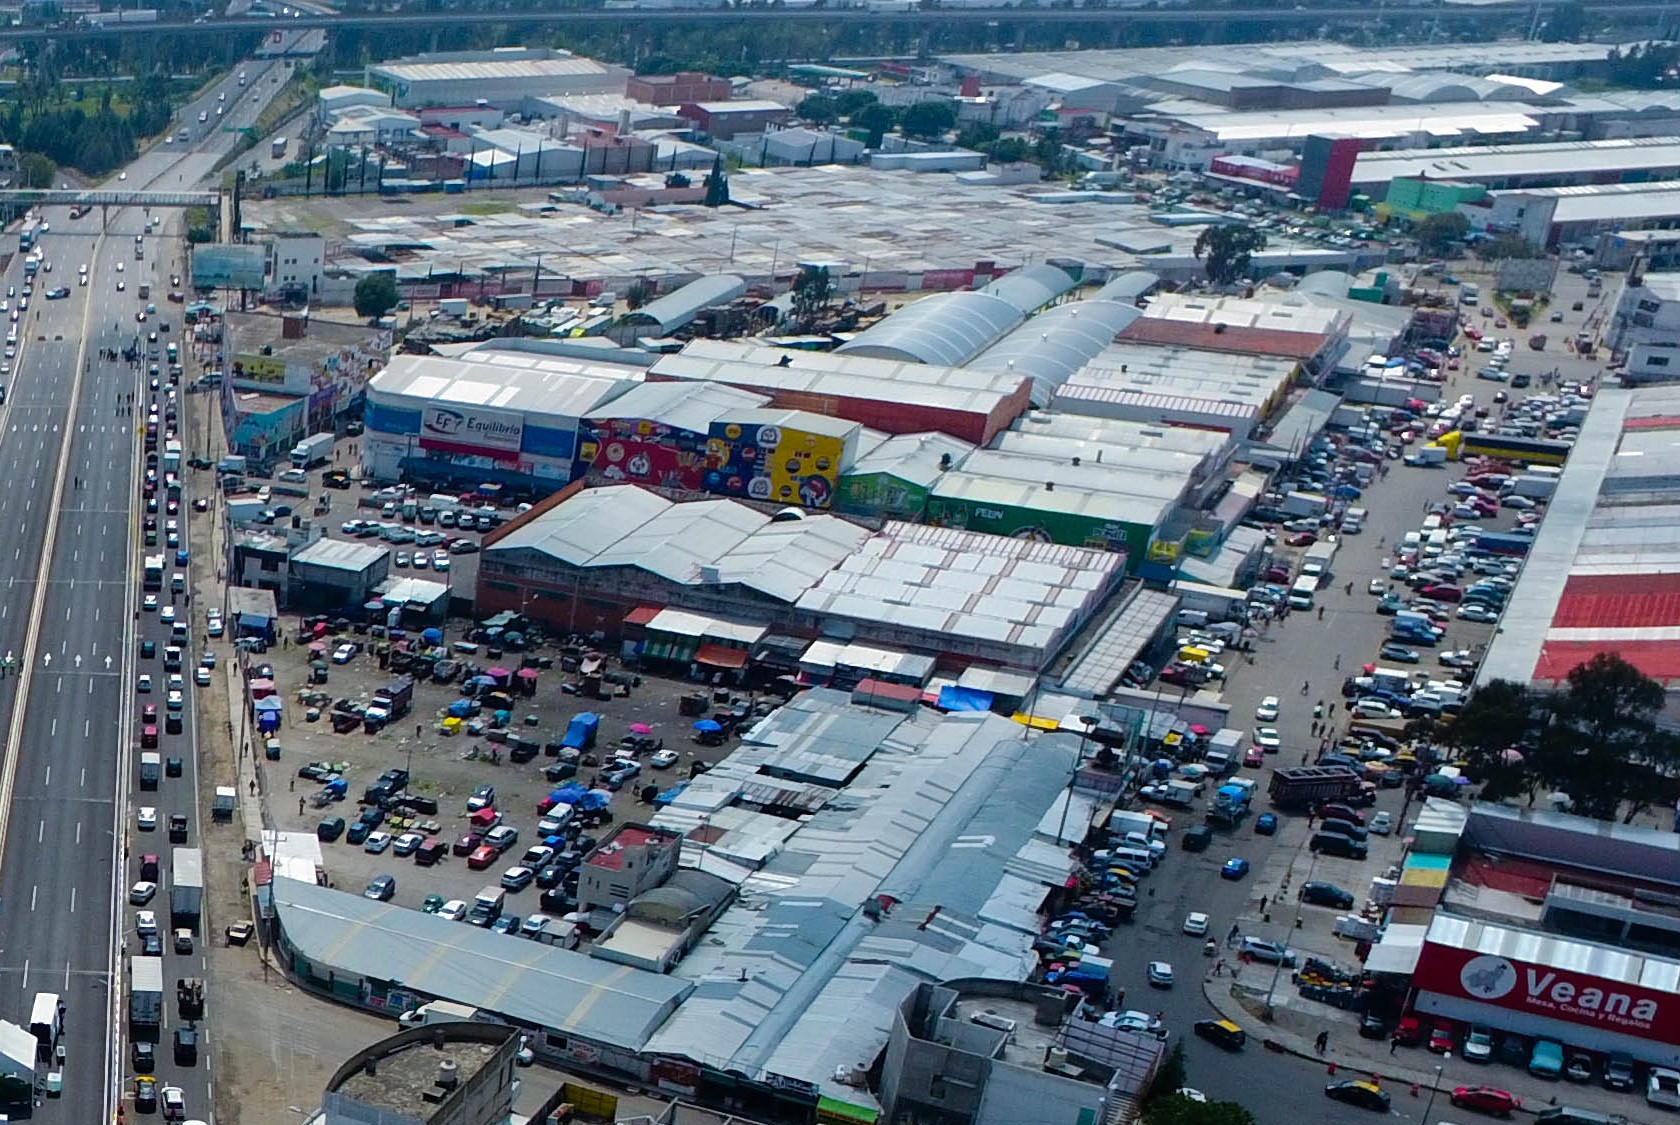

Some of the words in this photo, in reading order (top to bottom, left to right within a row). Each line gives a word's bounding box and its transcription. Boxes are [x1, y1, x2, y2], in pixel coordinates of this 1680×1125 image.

[466, 416, 520, 436] Equilibrio
[1526, 968, 1658, 1022] Veana
[1560, 1001, 1596, 1018] Cocina
[1598, 1012, 1606, 1021] y
[1607, 1012, 1651, 1030] Regalos
